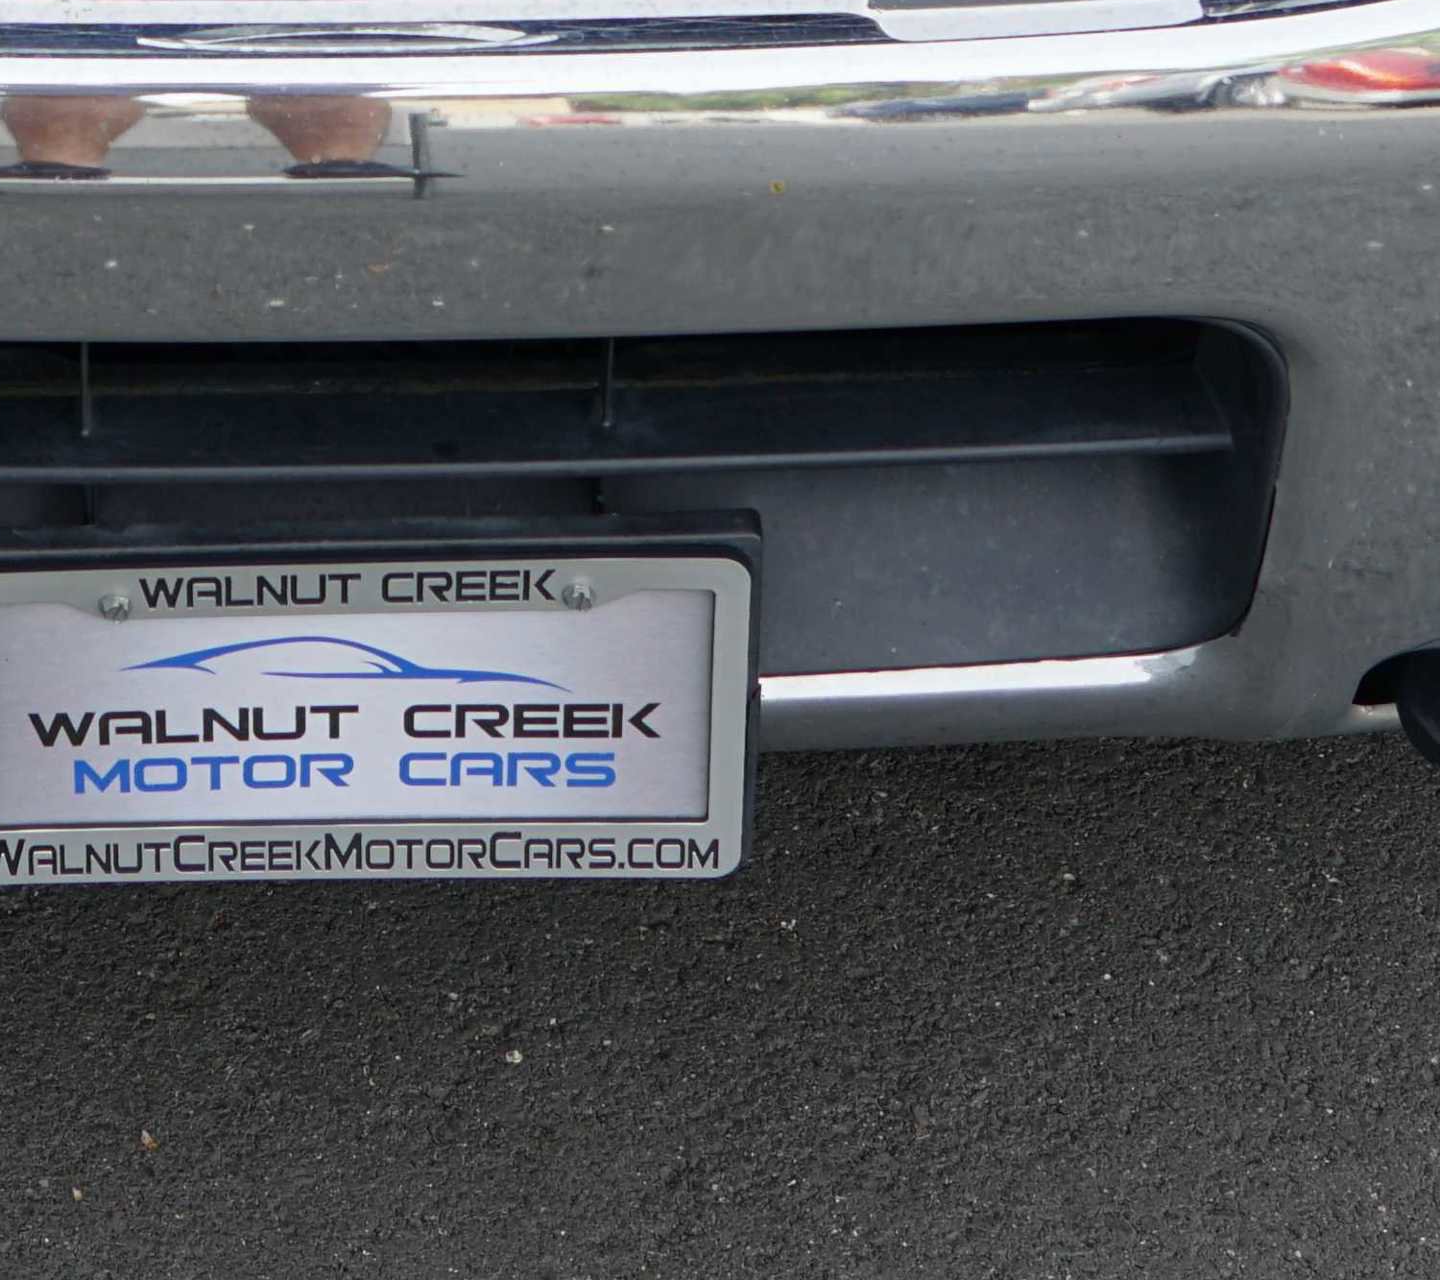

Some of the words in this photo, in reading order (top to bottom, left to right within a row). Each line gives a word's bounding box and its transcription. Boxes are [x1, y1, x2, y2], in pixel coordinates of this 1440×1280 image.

[138, 572, 362, 609] WALNUT
[380, 568, 557, 603] CREEK
[27, 704, 360, 748] WALNUT
[402, 702, 663, 740] CREEK
[72, 753, 355, 795] MOTOR
[397, 751, 617, 789] CARS
